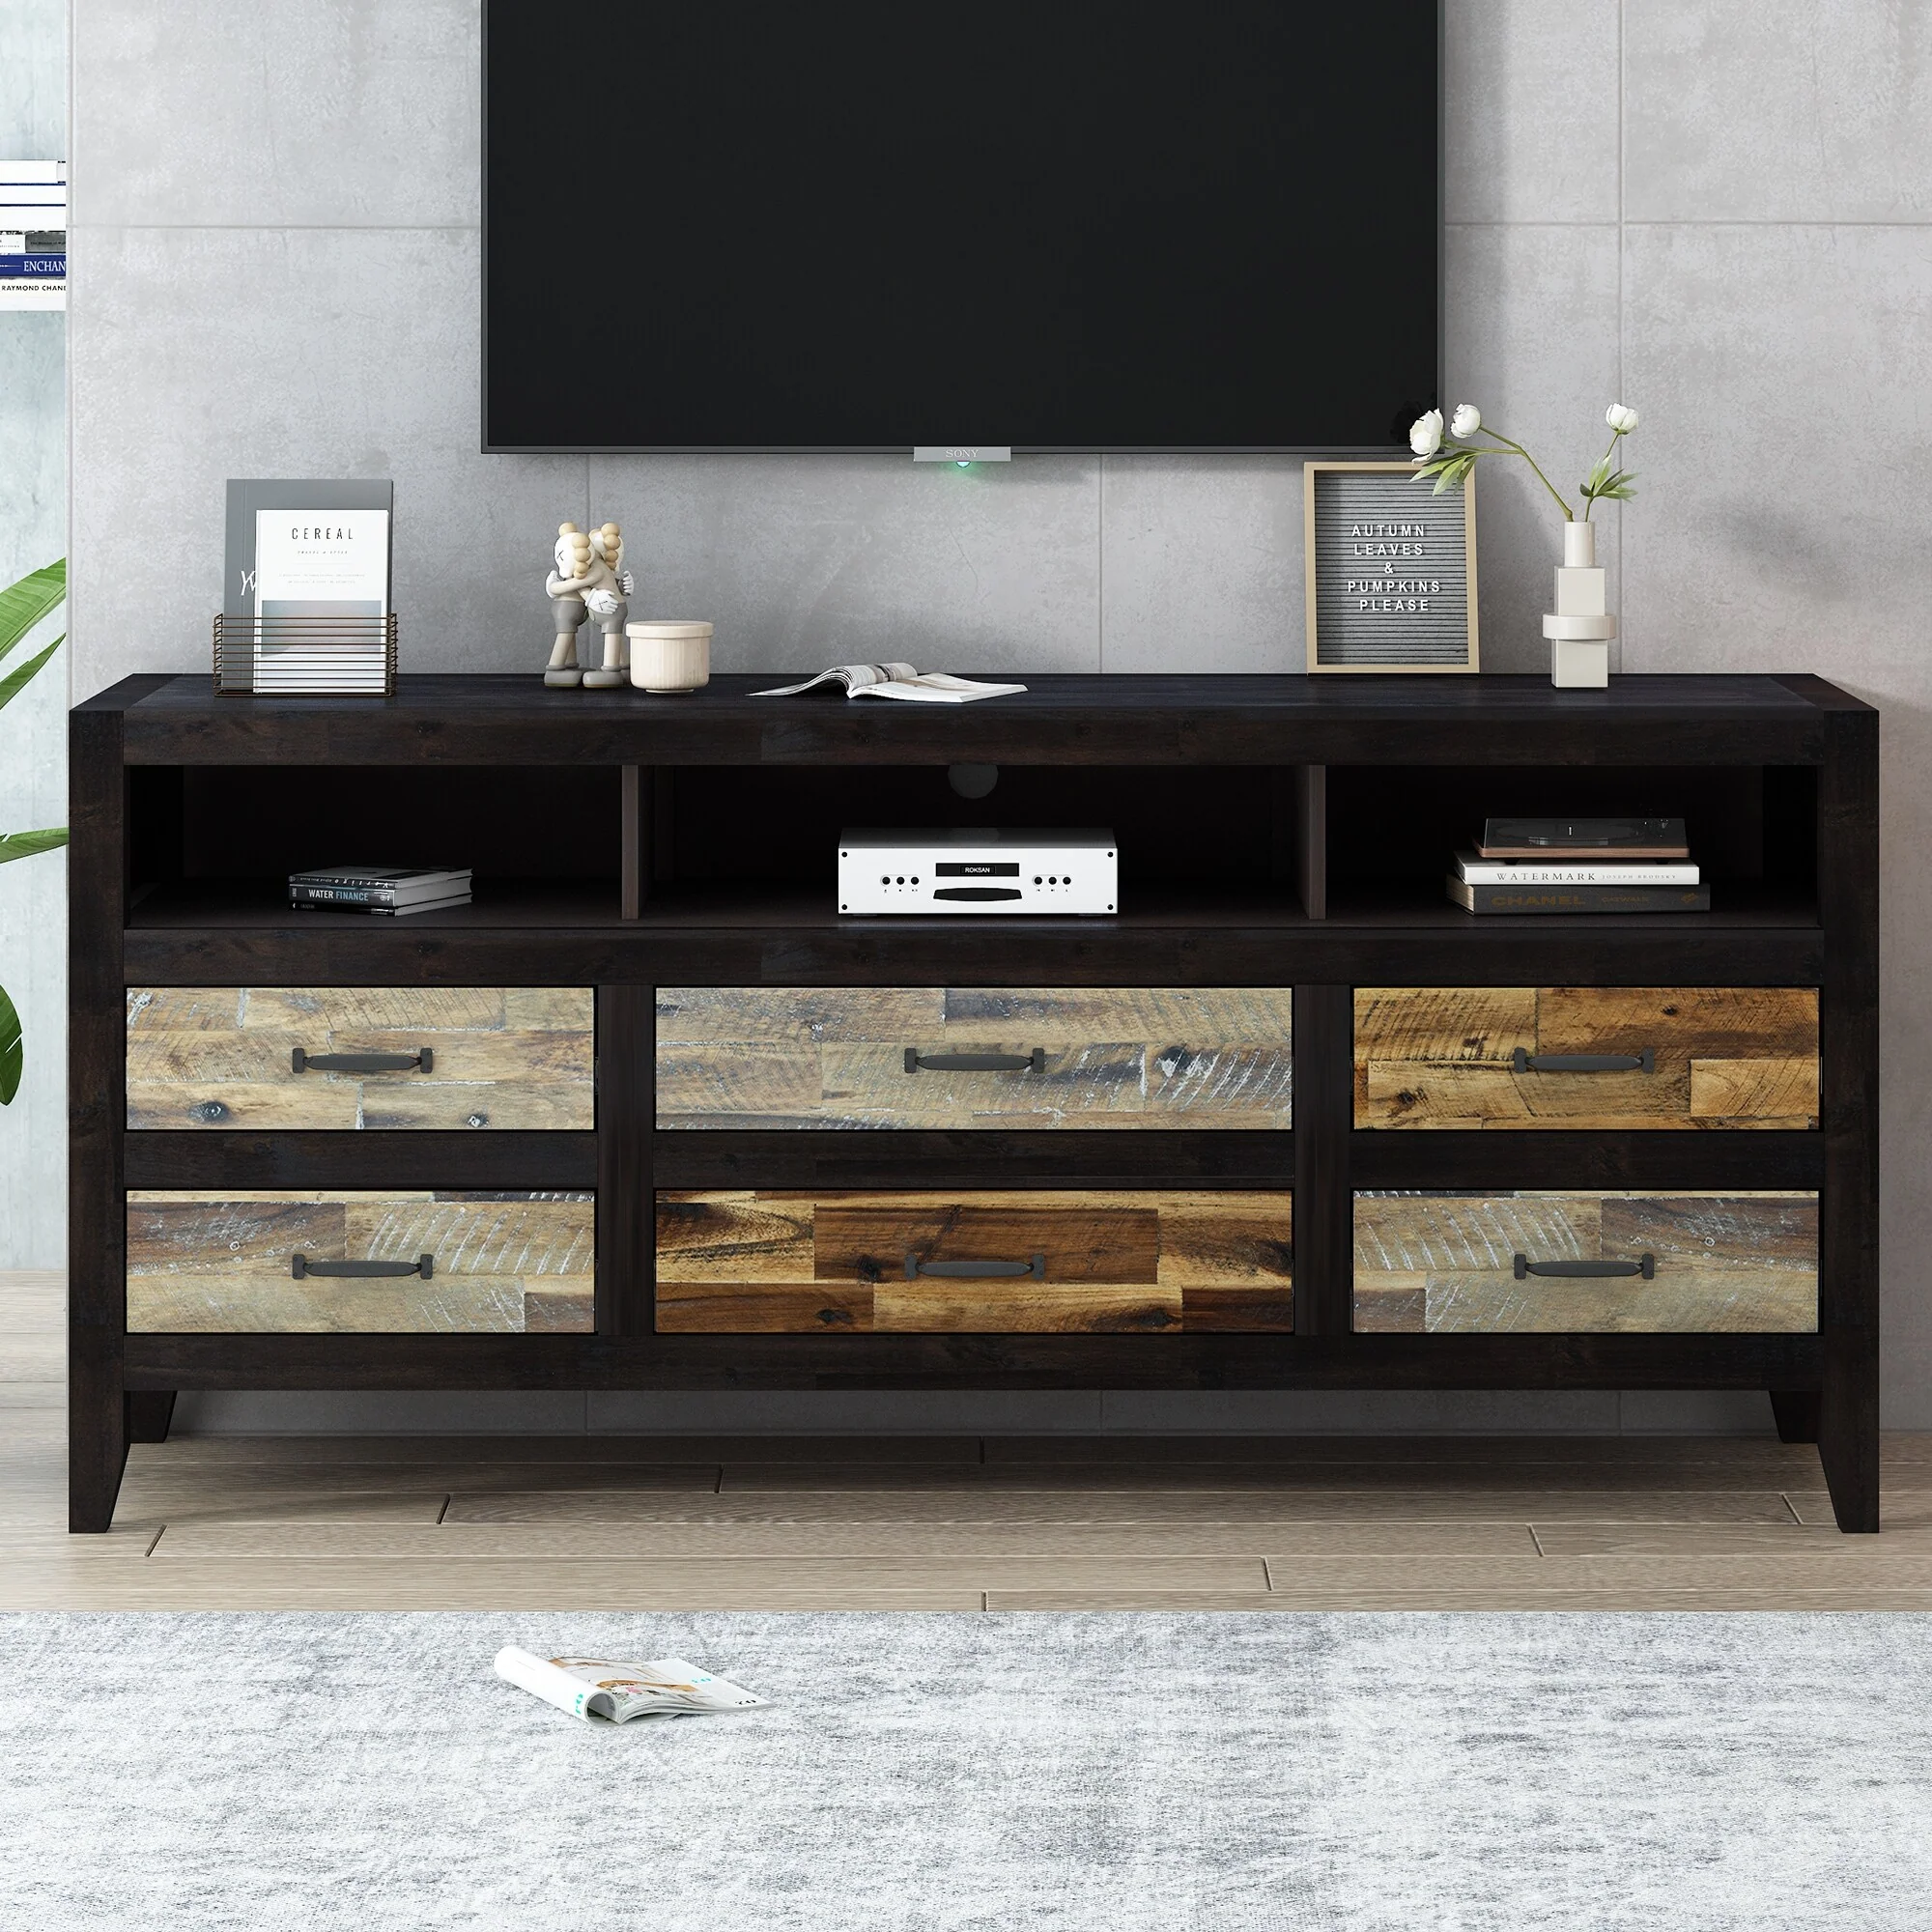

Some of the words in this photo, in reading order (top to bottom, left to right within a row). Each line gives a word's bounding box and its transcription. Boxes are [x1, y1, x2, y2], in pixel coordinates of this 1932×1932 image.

[946, 449, 979, 458] SONY
[292, 527, 354, 540] CEREAL
[1351, 525, 1425, 537] AUTUMN
[1354, 544, 1424, 555] LEAVES
[1384, 561, 1394, 574] &
[1348, 581, 1440, 593] PUMPKINS
[1359, 599, 1430, 611] PLEASE
[1496, 872, 1596, 881] WATERMARK
[308, 889, 334, 899] WATER
[335, 891, 369, 901] FINANCE
[1491, 895, 1585, 906] CHANEL
